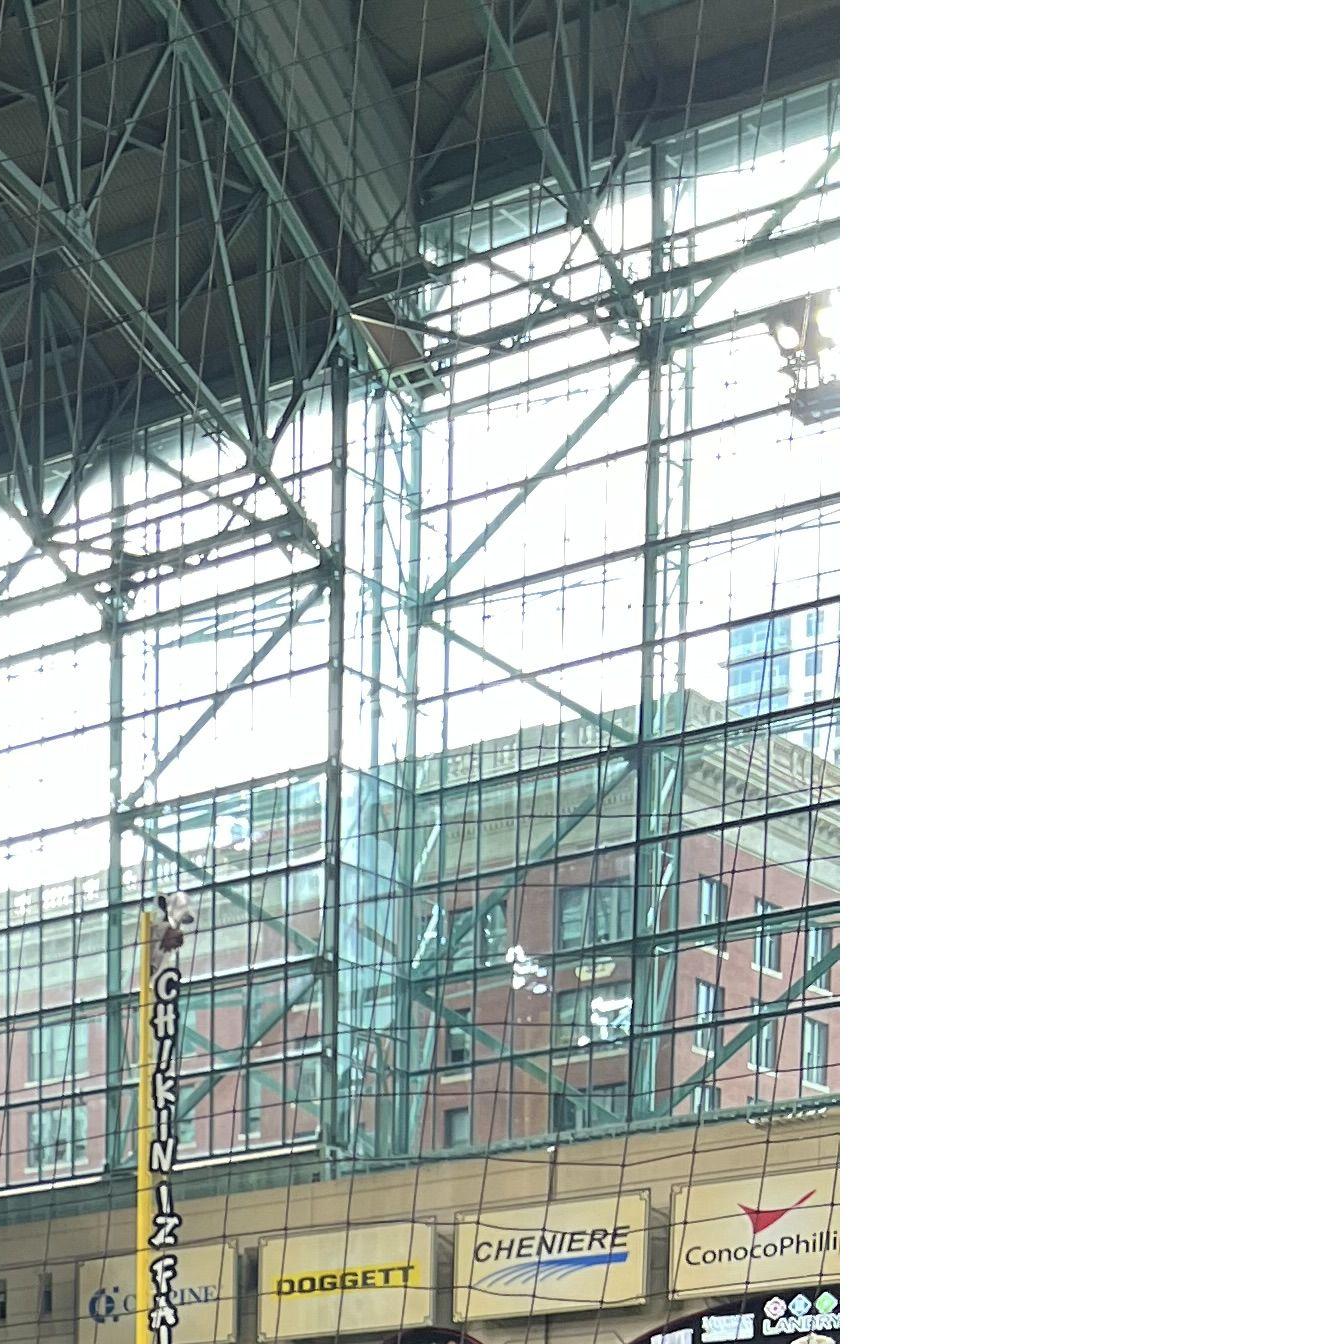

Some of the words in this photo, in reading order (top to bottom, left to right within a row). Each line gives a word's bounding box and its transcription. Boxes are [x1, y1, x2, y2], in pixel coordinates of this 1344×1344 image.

[151, 967, 181, 1177] CHIKIN
[150, 1181, 179, 1246] IZ
[474, 1226, 630, 1263] CHENIERE
[685, 1230, 839, 1266] ConocoPhilli
[276, 1265, 415, 1297] DOGGETT
[123, 1285, 219, 1314] CPINE
[762, 1312, 840, 1337] LANDRY
